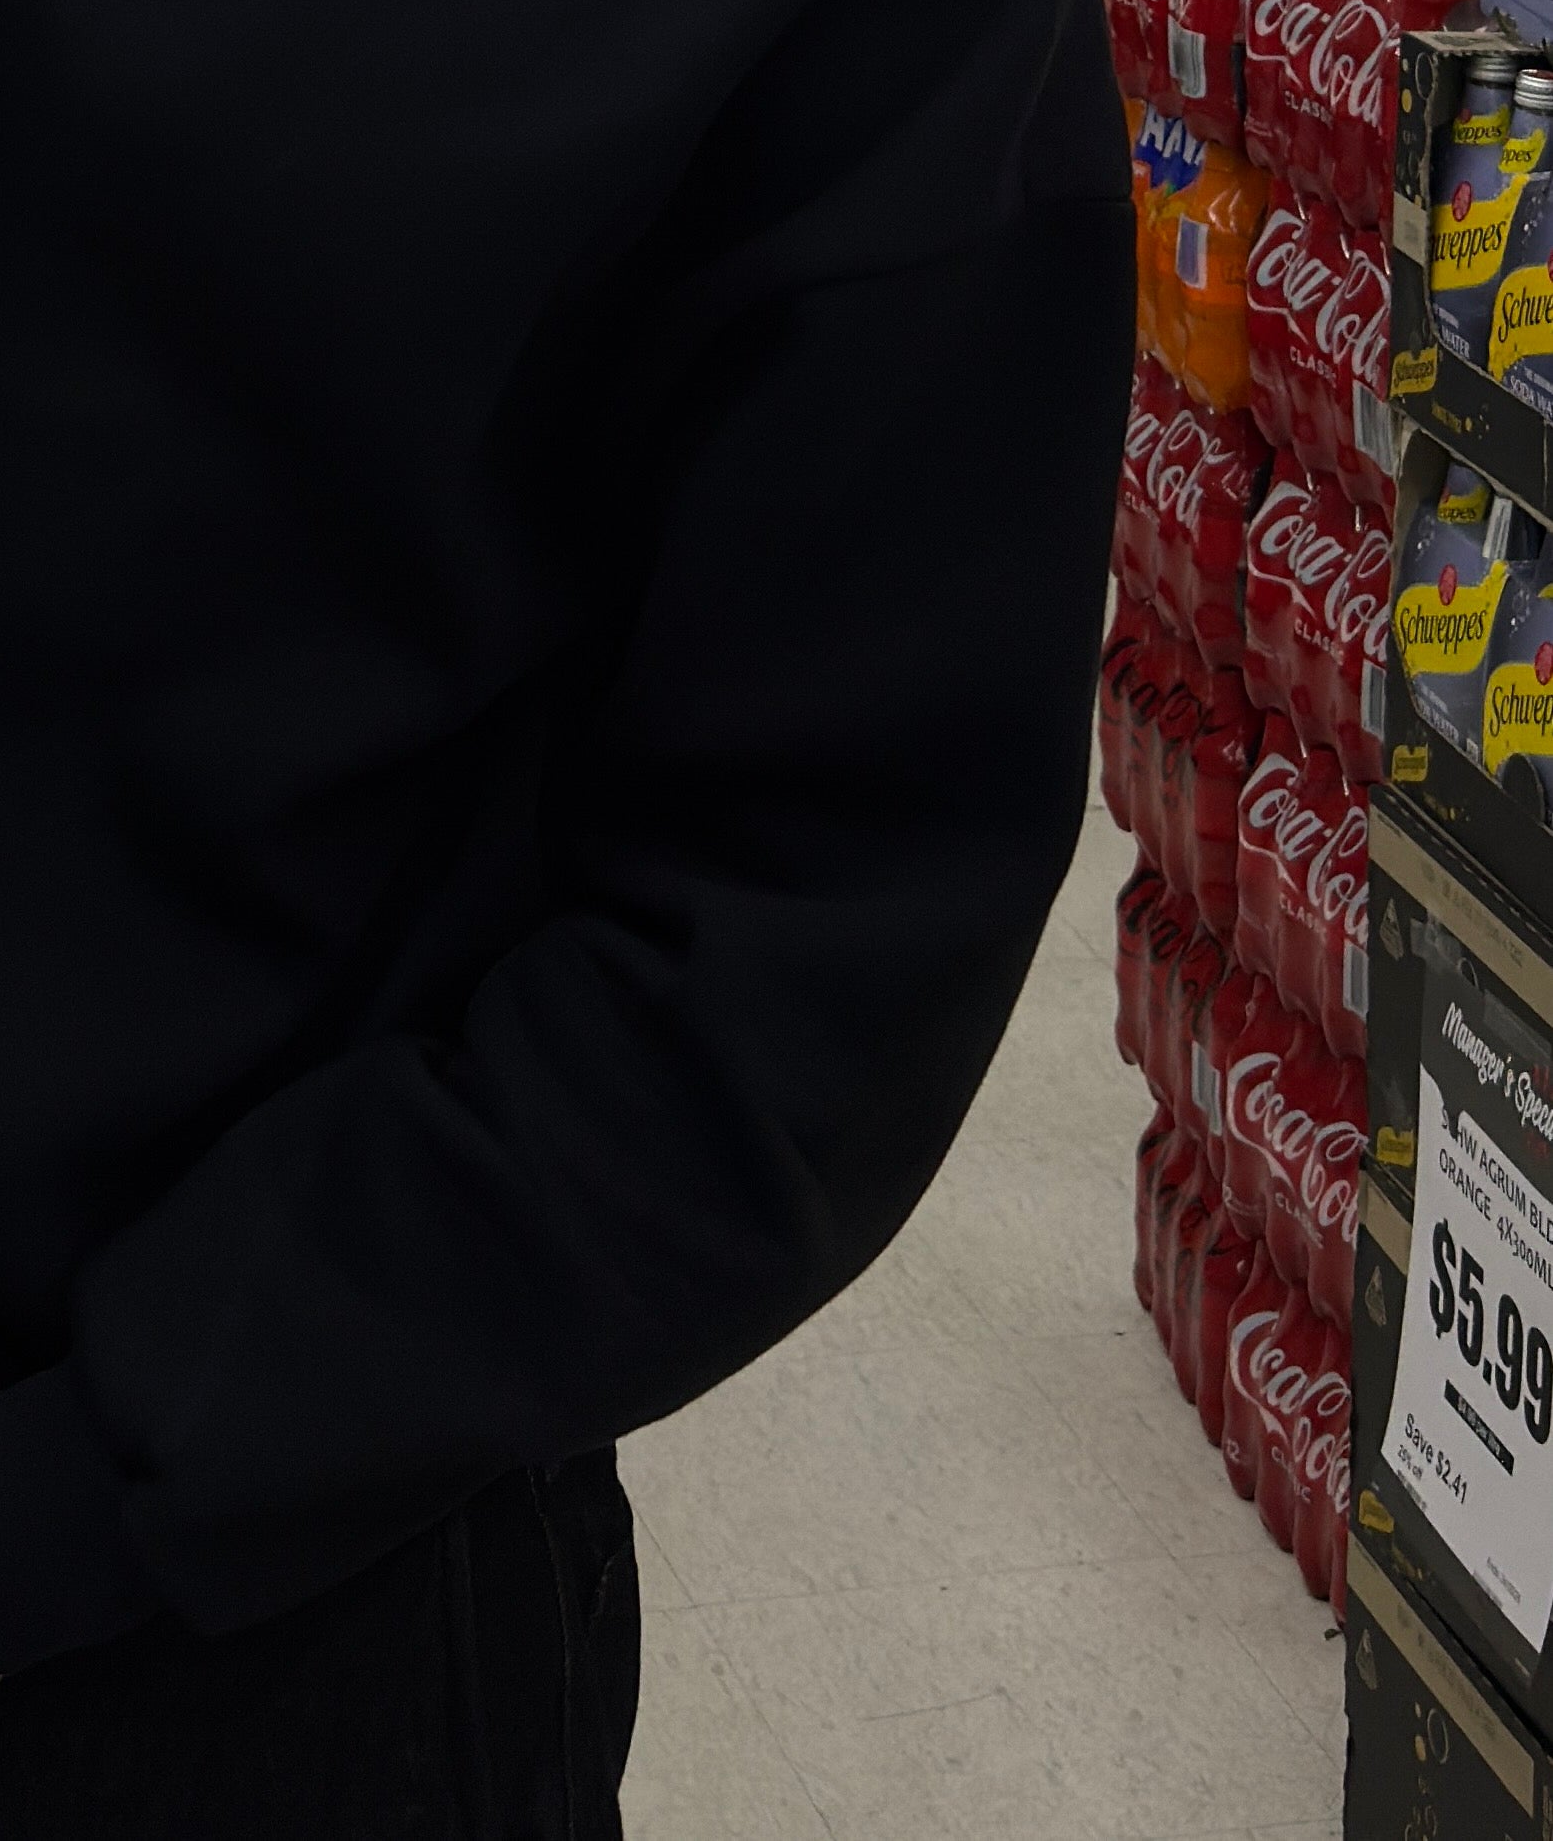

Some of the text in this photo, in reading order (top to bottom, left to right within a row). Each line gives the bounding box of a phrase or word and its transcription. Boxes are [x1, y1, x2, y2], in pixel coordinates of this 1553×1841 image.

[1431, 219, 1508, 270] weppes
[1497, 285, 1553, 344] Schwe
[1399, 607, 1488, 657] Schweppes
[1490, 683, 1553, 738] Schwep
[1441, 1001, 1516, 1098] Manager's
[1438, 1148, 1491, 1222] ORANGE
[1479, 1149, 1526, 1216] AGRUM
[1429, 1217, 1552, 1445] $5.99
[1404, 1412, 1434, 1464] Save
[1435, 1450, 1468, 1505] $2.41
